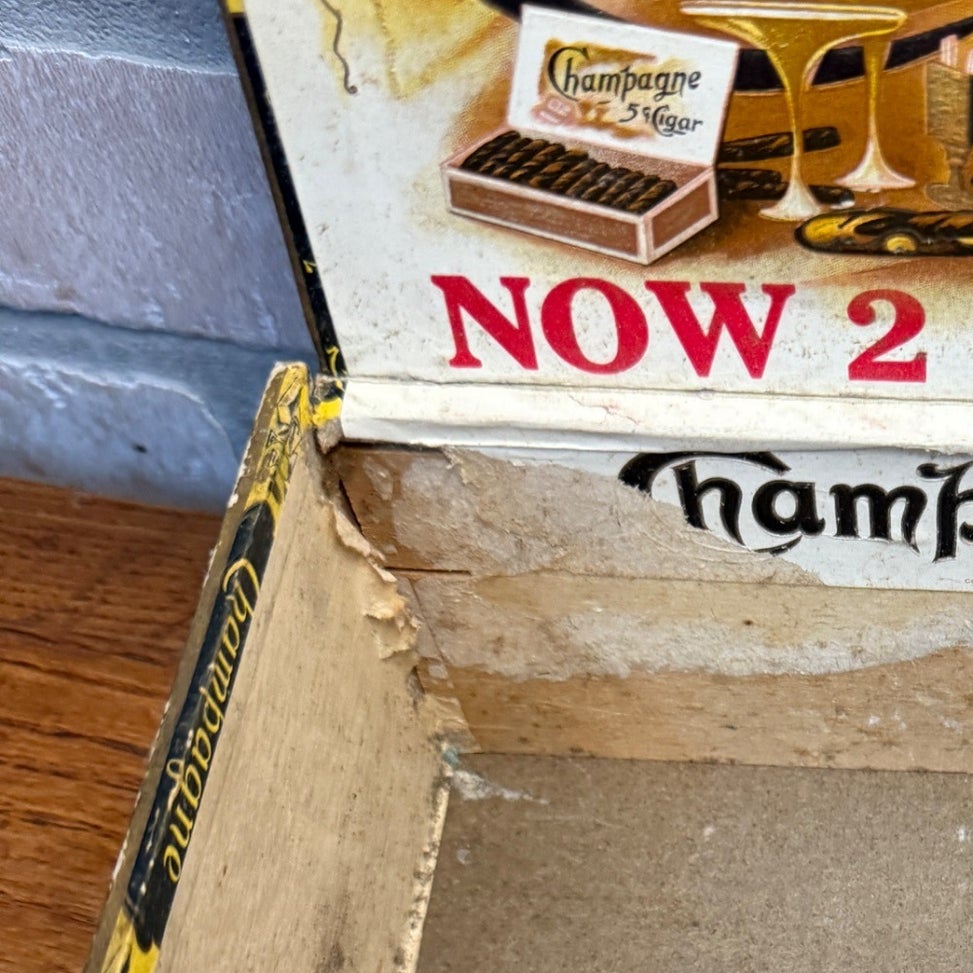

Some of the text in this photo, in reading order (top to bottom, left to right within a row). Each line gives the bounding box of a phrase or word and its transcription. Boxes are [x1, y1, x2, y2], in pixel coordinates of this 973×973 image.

[547, 46, 702, 103] Champagne
[651, 104, 703, 137] Cigar
[430, 274, 797, 380] NOW
[847, 289, 927, 383] 2
[163, 557, 261, 883] Champagne
